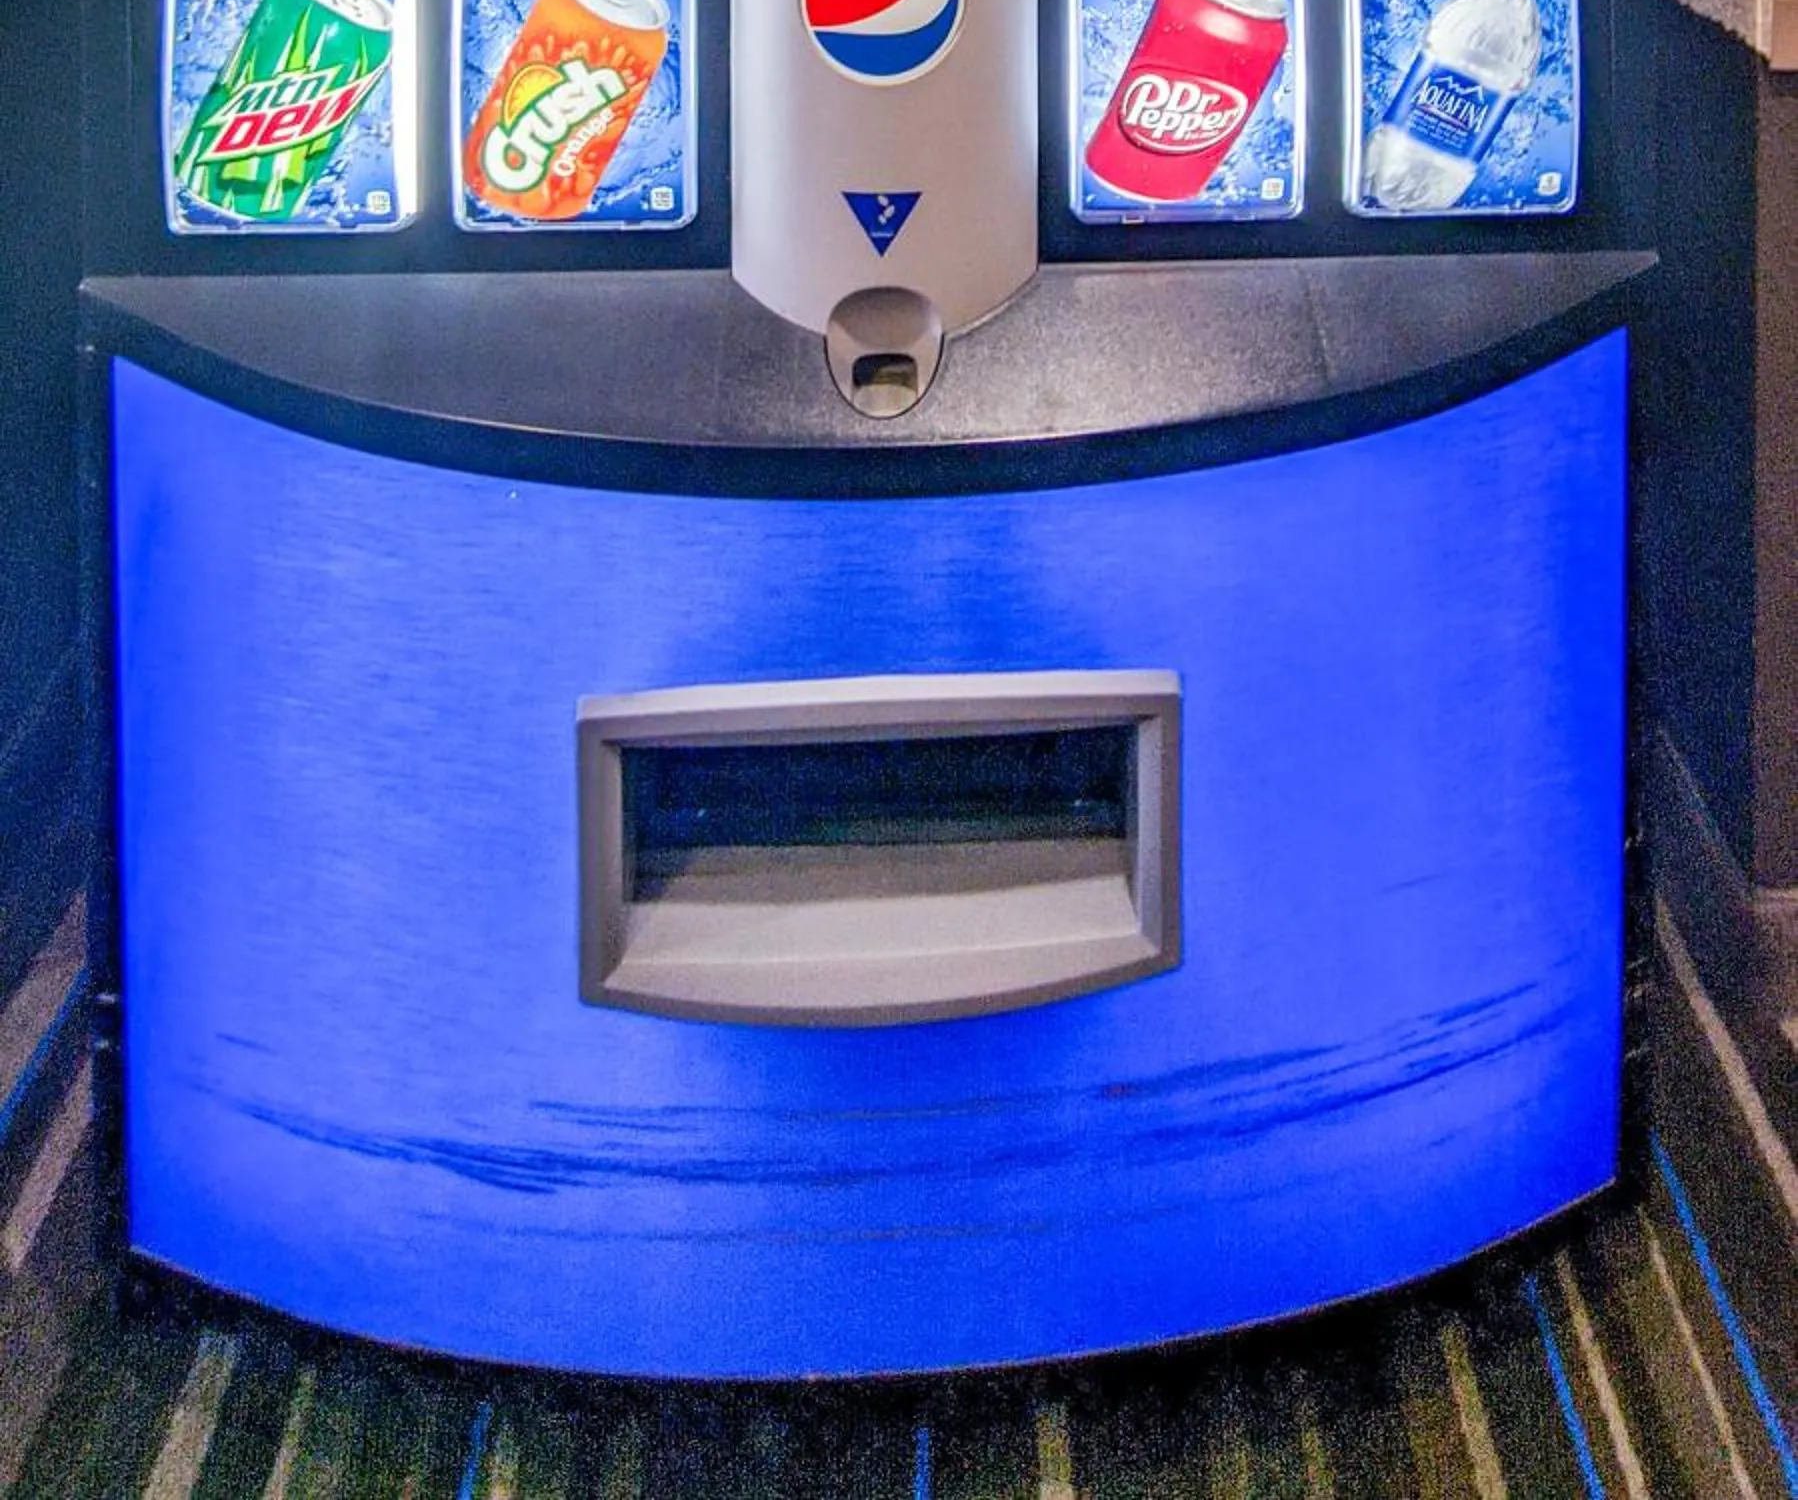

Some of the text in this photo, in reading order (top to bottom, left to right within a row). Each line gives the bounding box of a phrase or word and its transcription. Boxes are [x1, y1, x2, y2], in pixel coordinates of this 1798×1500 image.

[483, 58, 629, 191] Crush
[1124, 73, 1240, 140] Pepper
[1167, 81, 1221, 114] Dr
[1412, 77, 1488, 133] AQUAFINA
